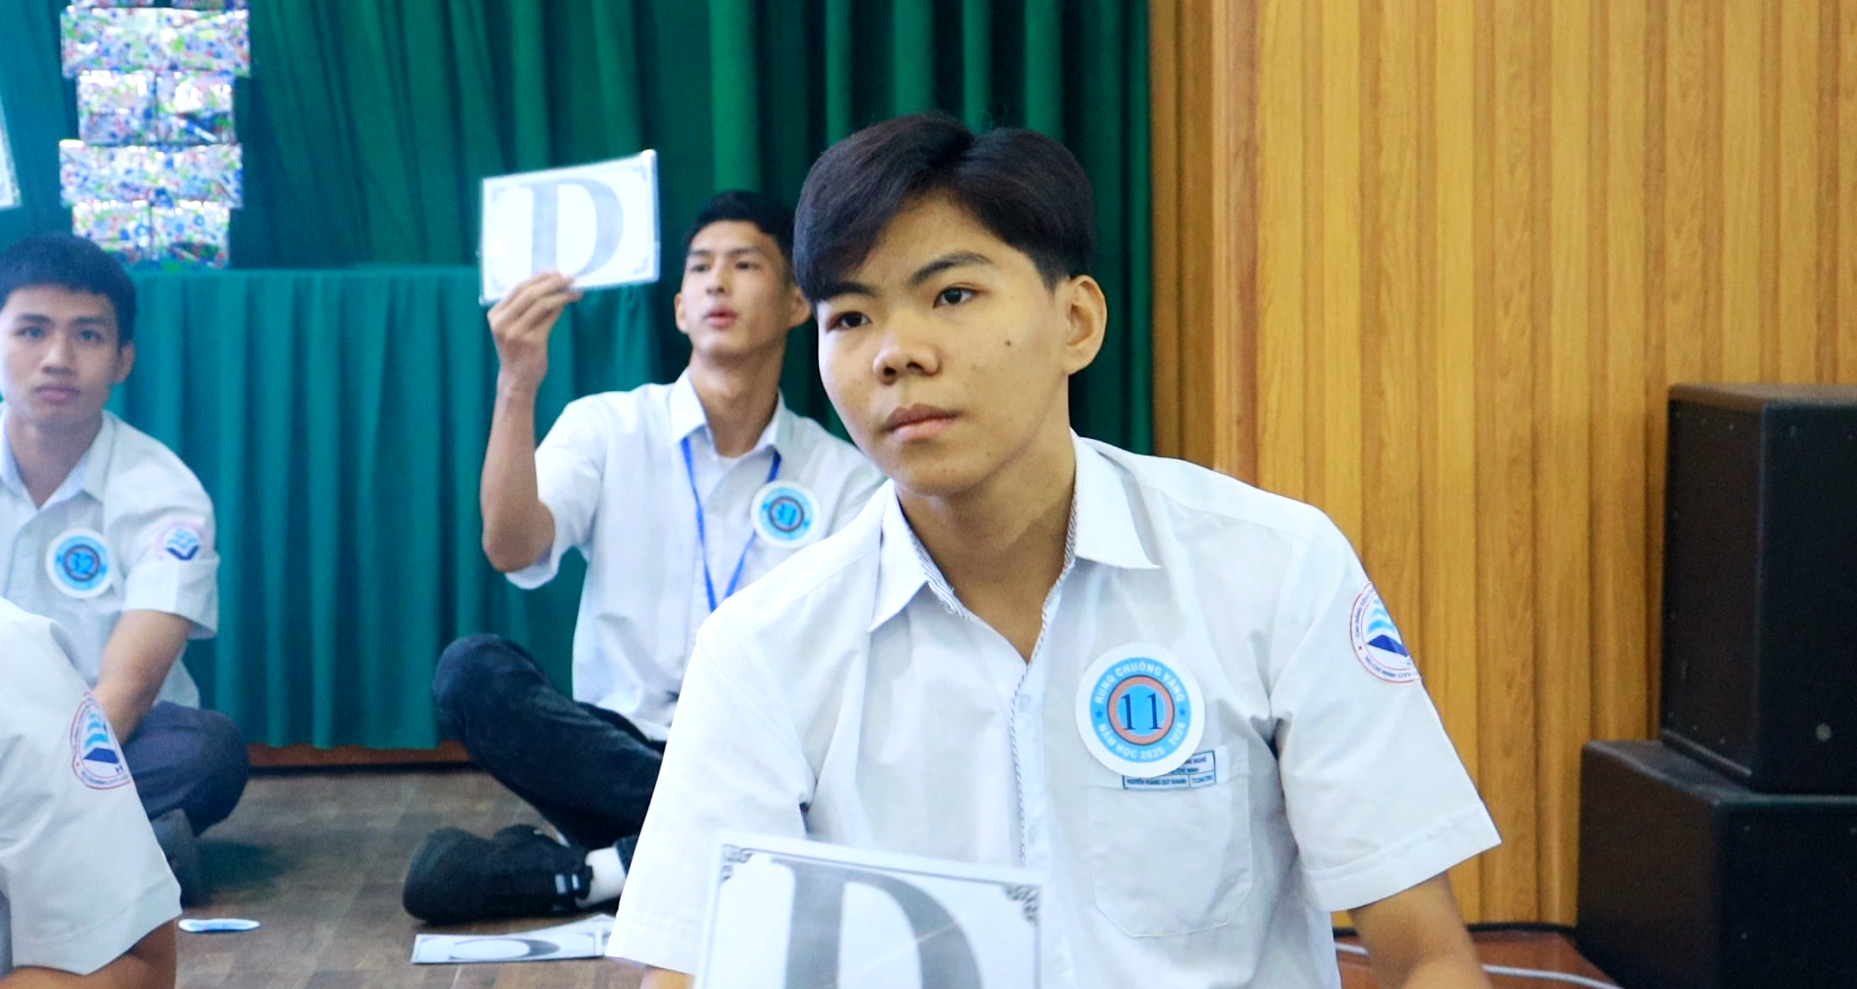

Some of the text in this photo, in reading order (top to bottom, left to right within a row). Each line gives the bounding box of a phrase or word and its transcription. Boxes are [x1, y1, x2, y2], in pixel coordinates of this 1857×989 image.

[517, 176, 624, 279] D
[1094, 660, 1185, 704] RUNG CHUÔNG VÀNG
[1121, 692, 1163, 731] 11
[1098, 723, 1118, 746] NĂM
[1115, 743, 1138, 759] HỌC
[1140, 746, 1165, 760] 2025
[770, 857, 985, 989] D
